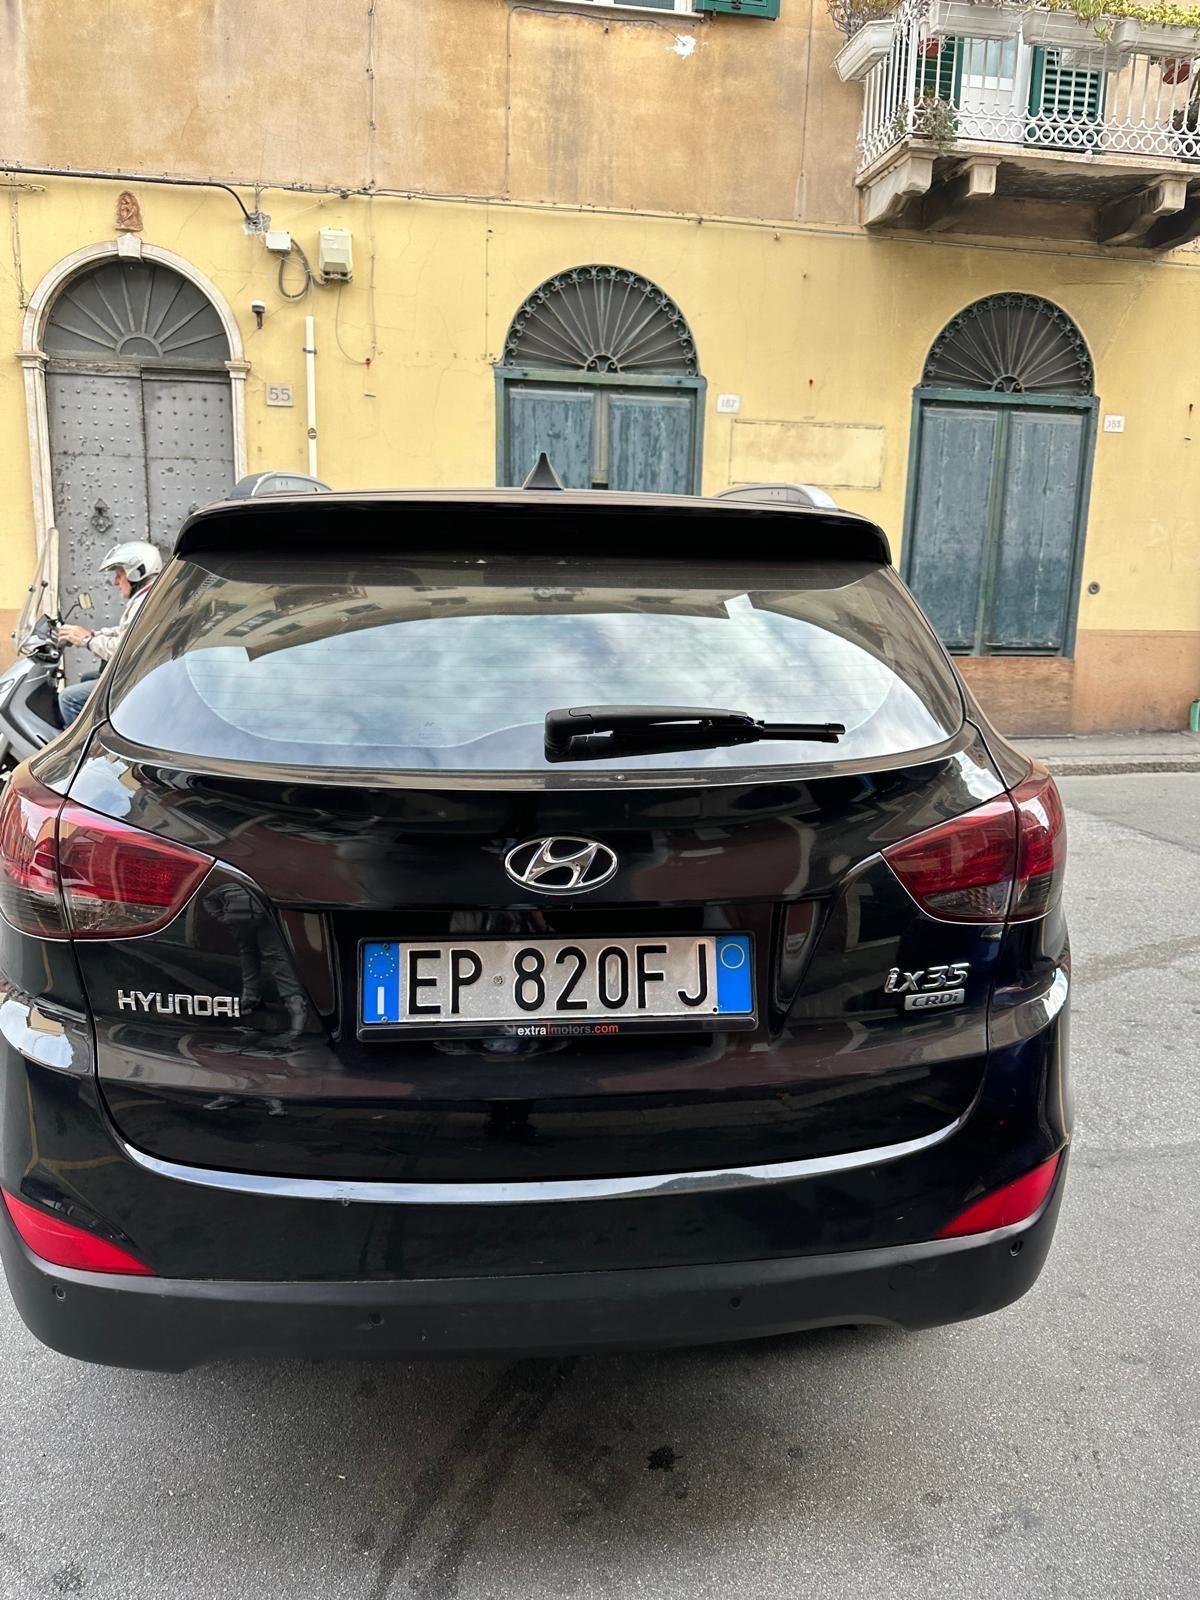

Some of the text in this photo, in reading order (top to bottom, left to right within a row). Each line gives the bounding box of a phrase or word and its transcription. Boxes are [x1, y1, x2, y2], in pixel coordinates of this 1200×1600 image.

[270, 387, 290, 401] 55
[407, 943, 709, 1015] EP 820FJ
[884, 962, 971, 993] ix35
[117, 989, 240, 1018] HYUNDAI
[911, 992, 960, 1007] CRDi
